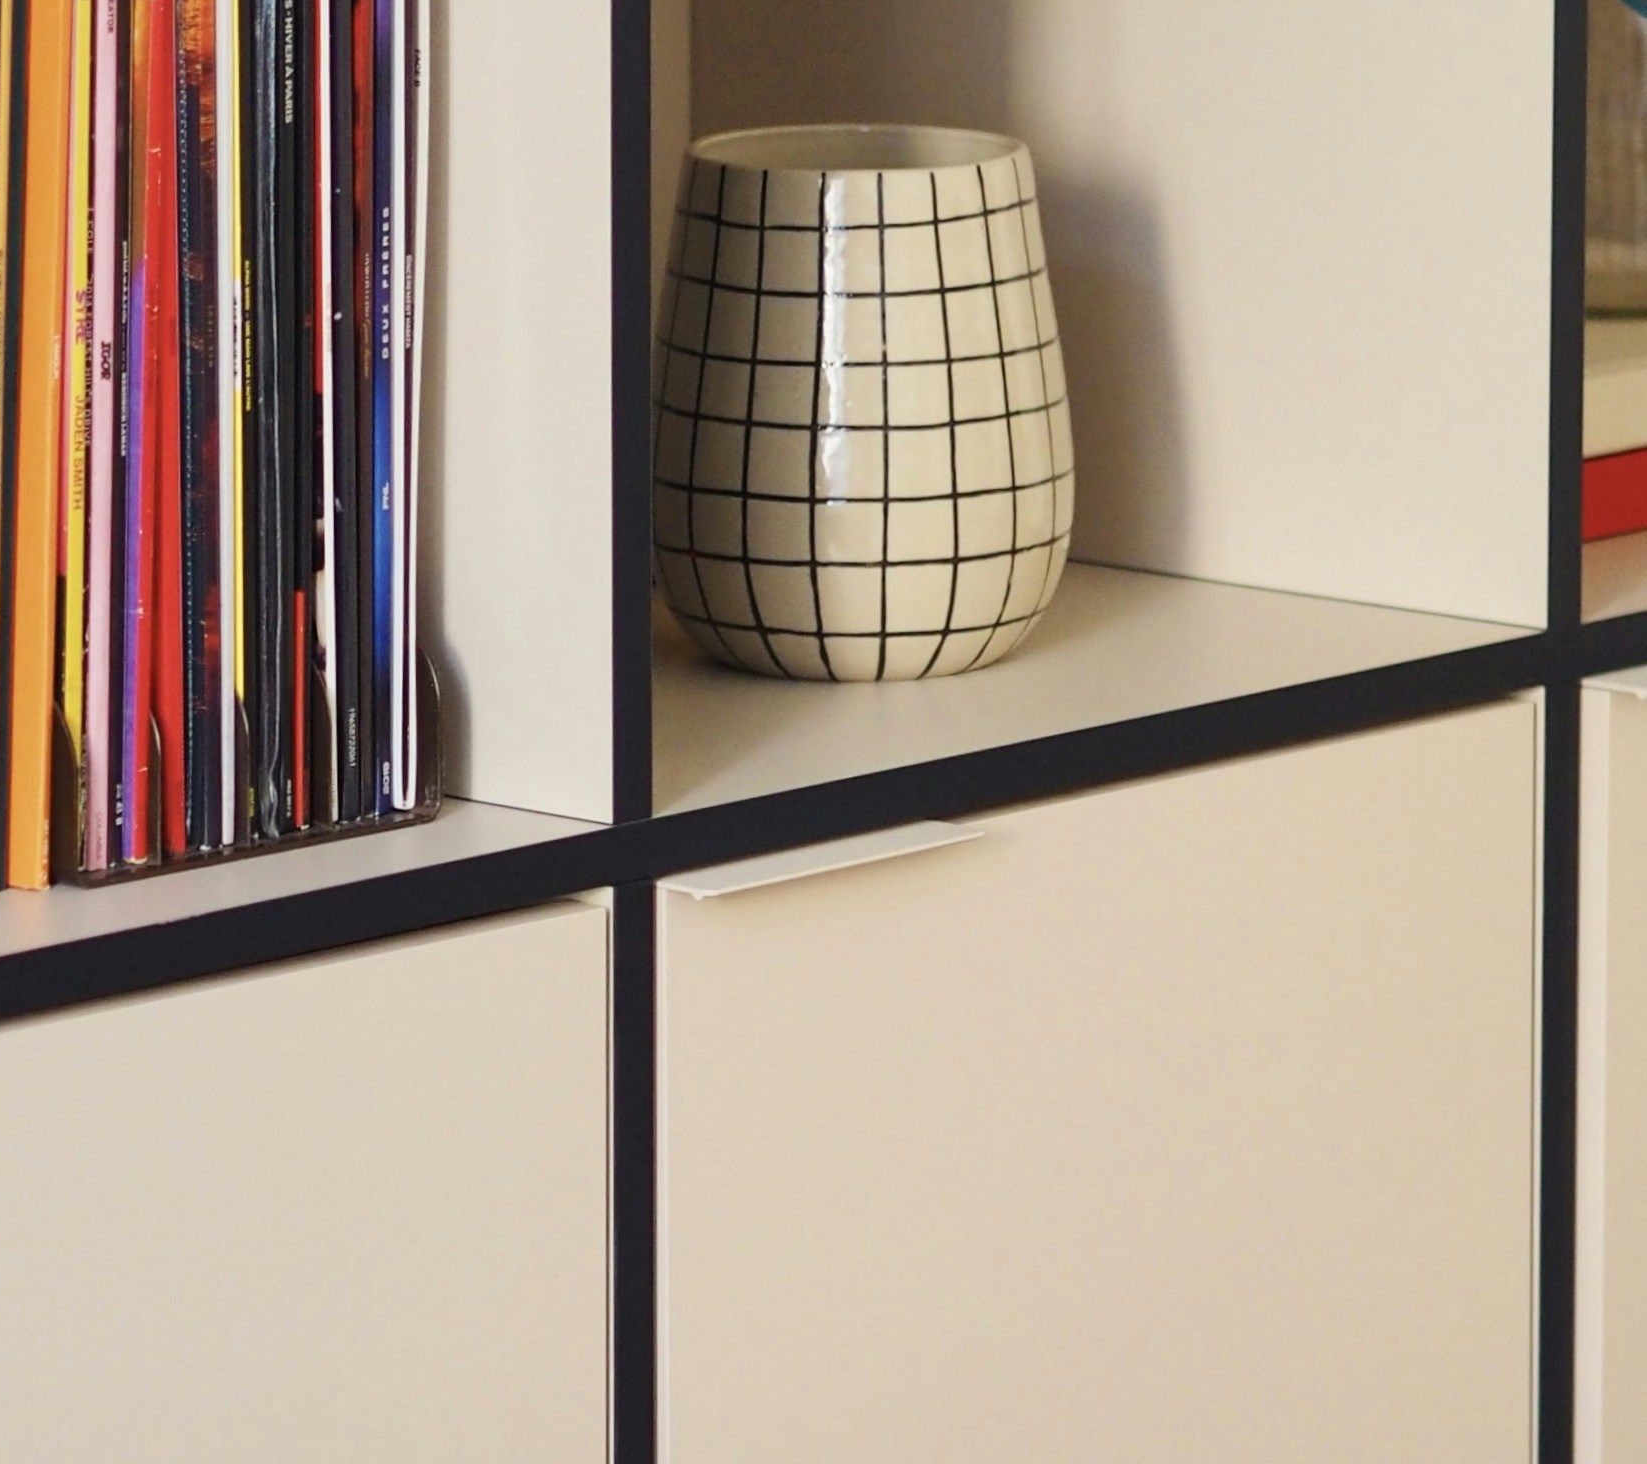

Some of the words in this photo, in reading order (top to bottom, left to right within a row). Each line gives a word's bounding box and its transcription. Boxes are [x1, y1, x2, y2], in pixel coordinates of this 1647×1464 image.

[284, 17, 293, 64] HIVER
[284, 79, 293, 124] PARIS
[75, 288, 87, 345] SYRE
[101, 341, 112, 381] IGOR
[72, 394, 84, 452] JADEN
[72, 456, 84, 511] SMITH
